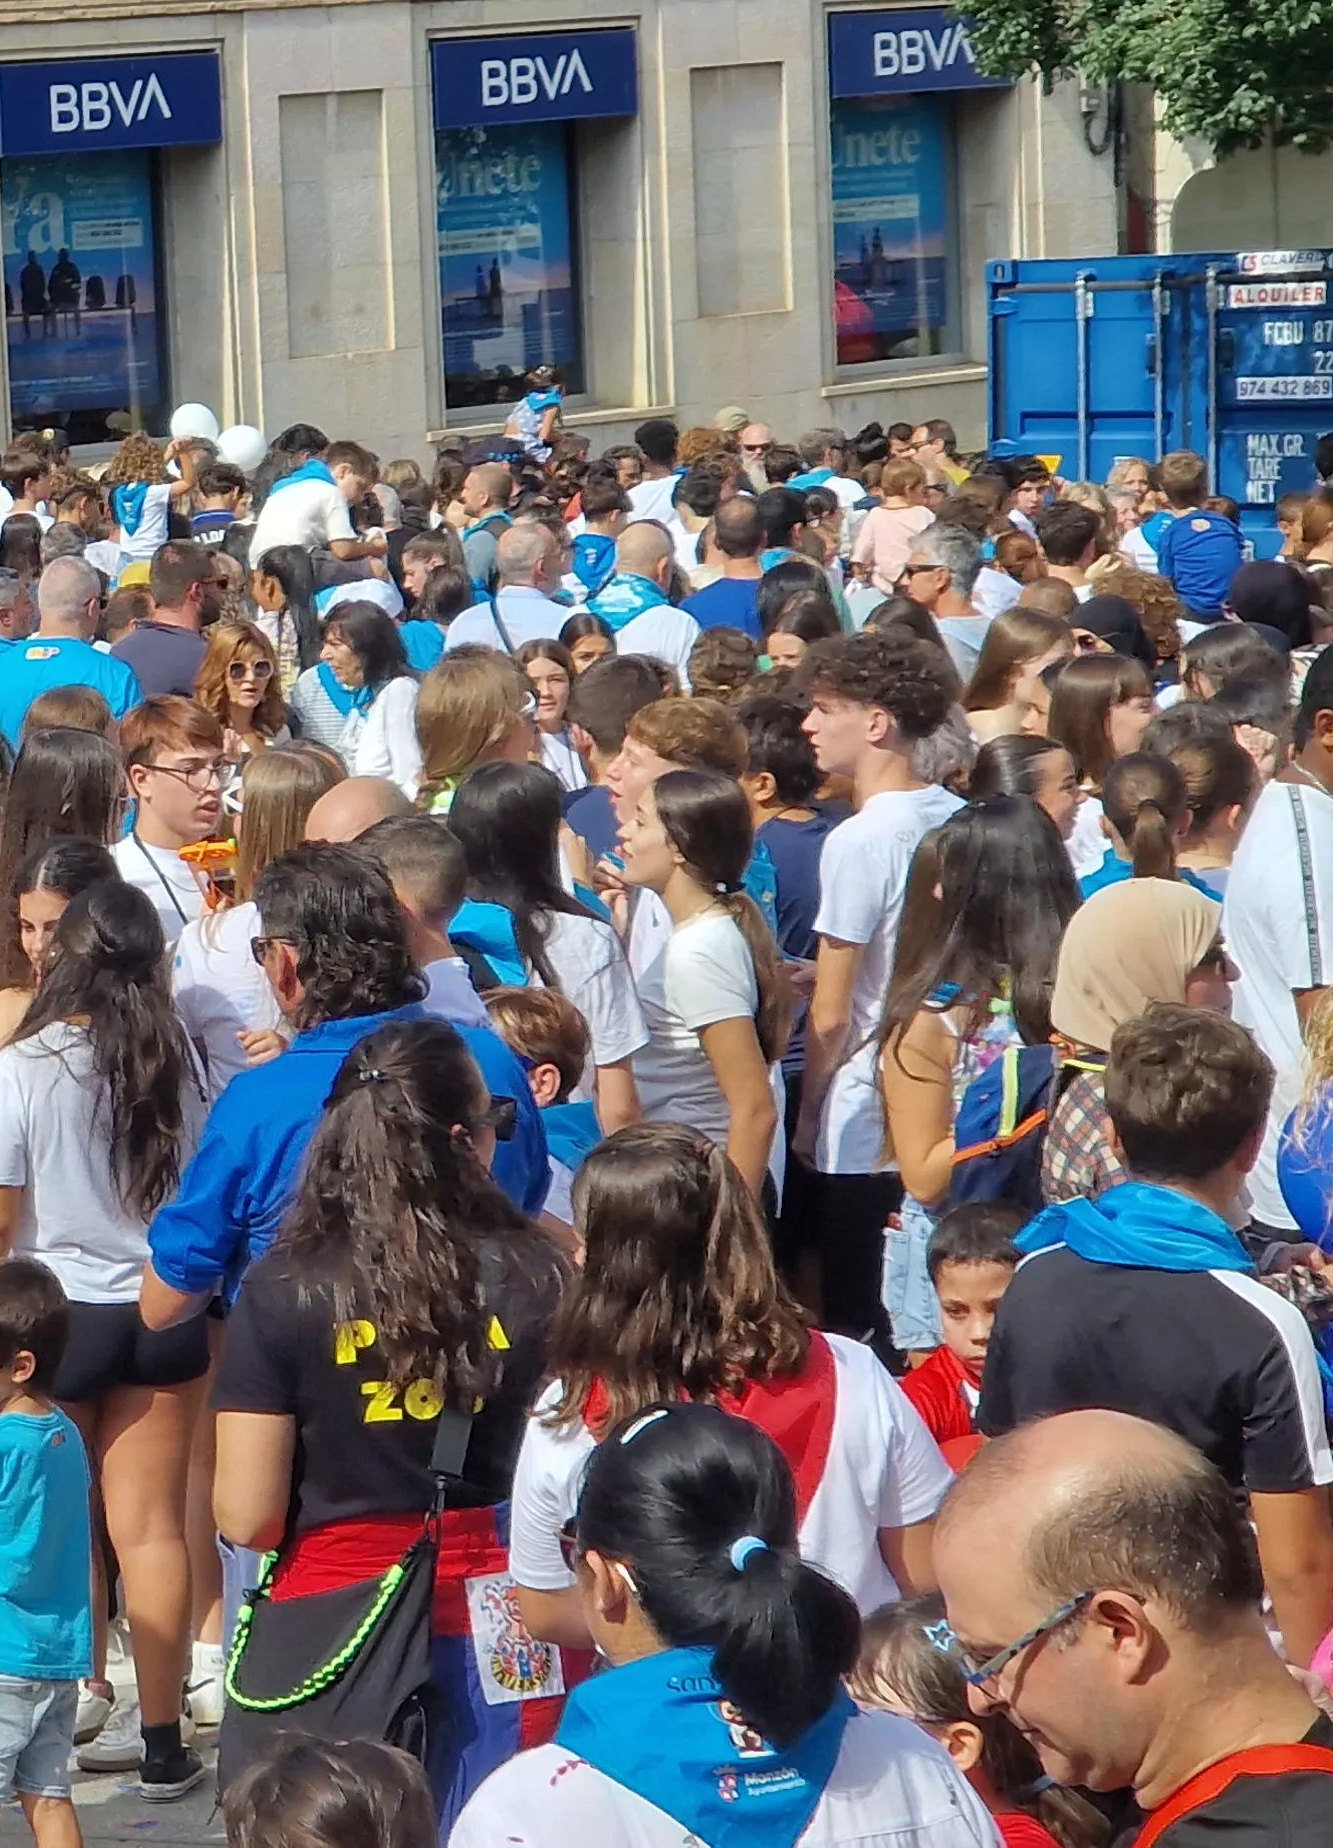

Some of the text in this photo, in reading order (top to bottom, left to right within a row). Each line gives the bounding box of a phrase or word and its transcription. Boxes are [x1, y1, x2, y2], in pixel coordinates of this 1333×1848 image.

[874, 22, 976, 76] BBVA
[481, 48, 594, 107] BBVA
[50, 72, 172, 133] BBVA
[1234, 286, 1325, 304] ALQUILER
[1264, 321, 1304, 346] FCBU
[1239, 381, 1267, 396] 974
[1271, 380, 1299, 395] 432
[1247, 457, 1282, 480] TARE
[1246, 480, 1276, 504] NET
